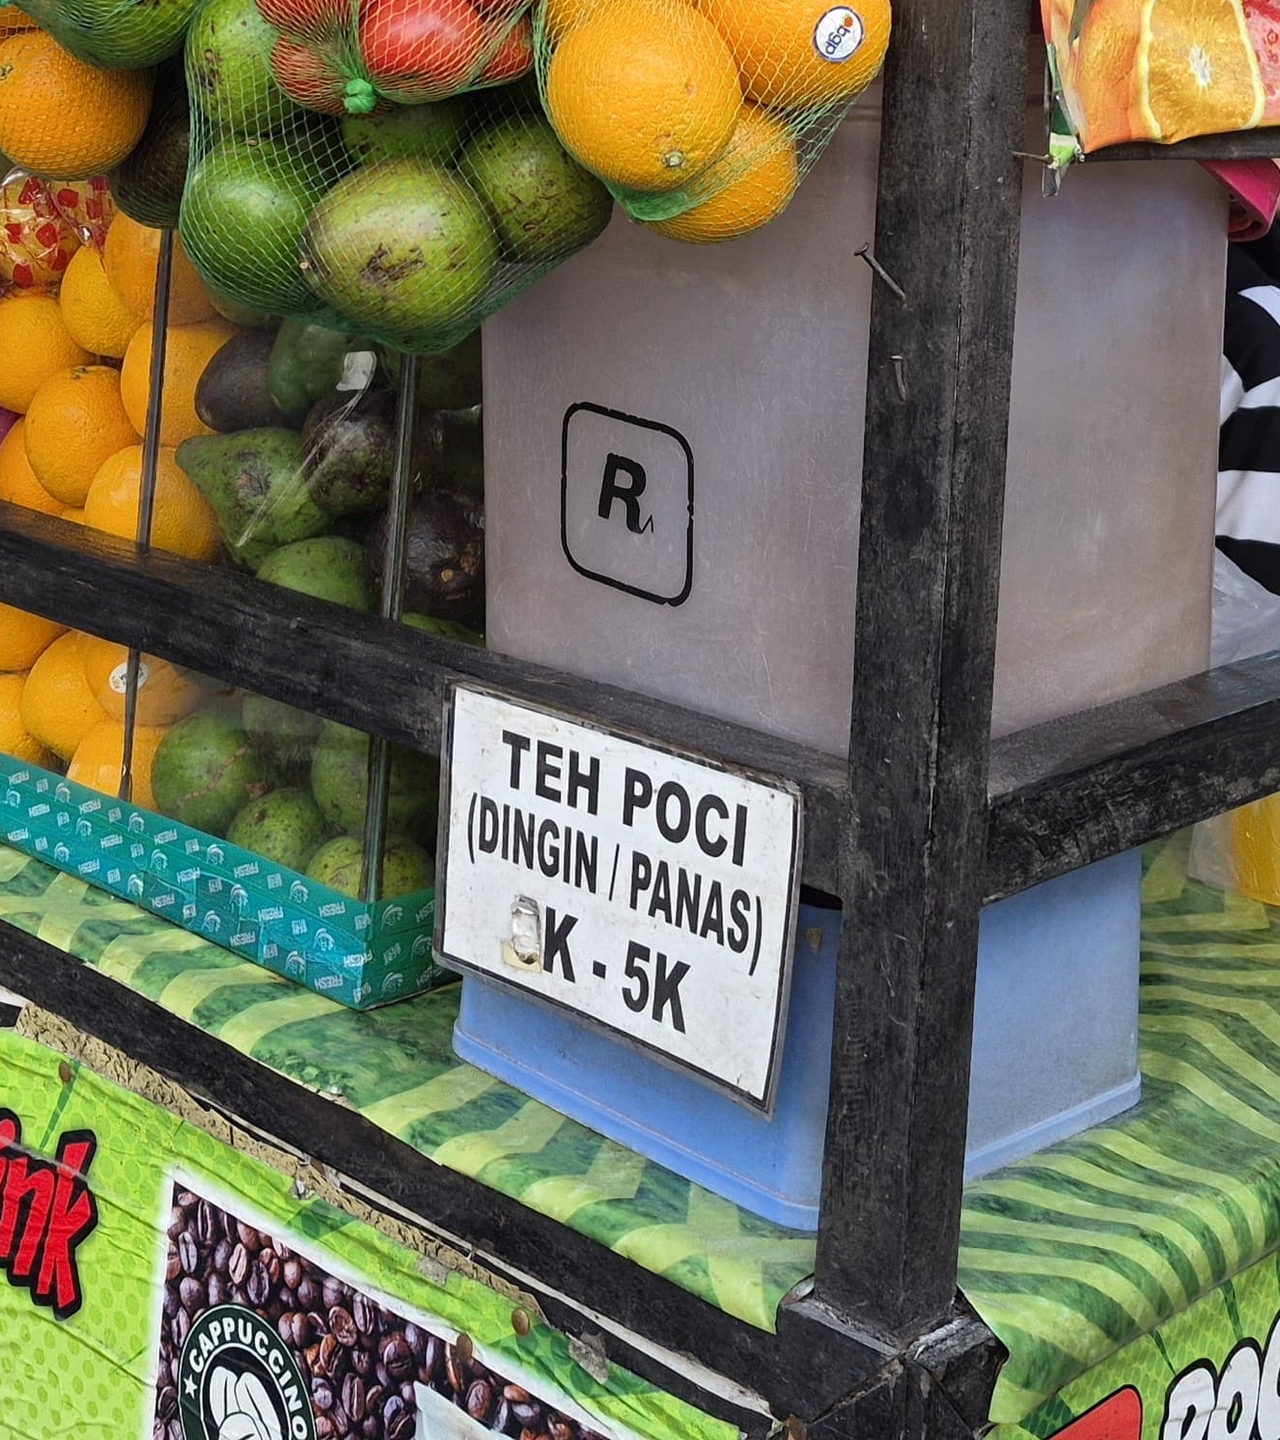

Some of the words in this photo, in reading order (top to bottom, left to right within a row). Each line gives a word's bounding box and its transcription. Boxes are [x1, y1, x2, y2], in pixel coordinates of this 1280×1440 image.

[597, 452, 645, 534] R
[502, 729, 600, 816] TEH
[623, 767, 748, 867] POCI
[467, 792, 598, 895] (DINGIN
[608, 843, 620, 902] /
[630, 850, 763, 976] PANAS)
[622, 940, 691, 1034] 5K
[189, 1317, 308, 1440] CAPPUCCINO
